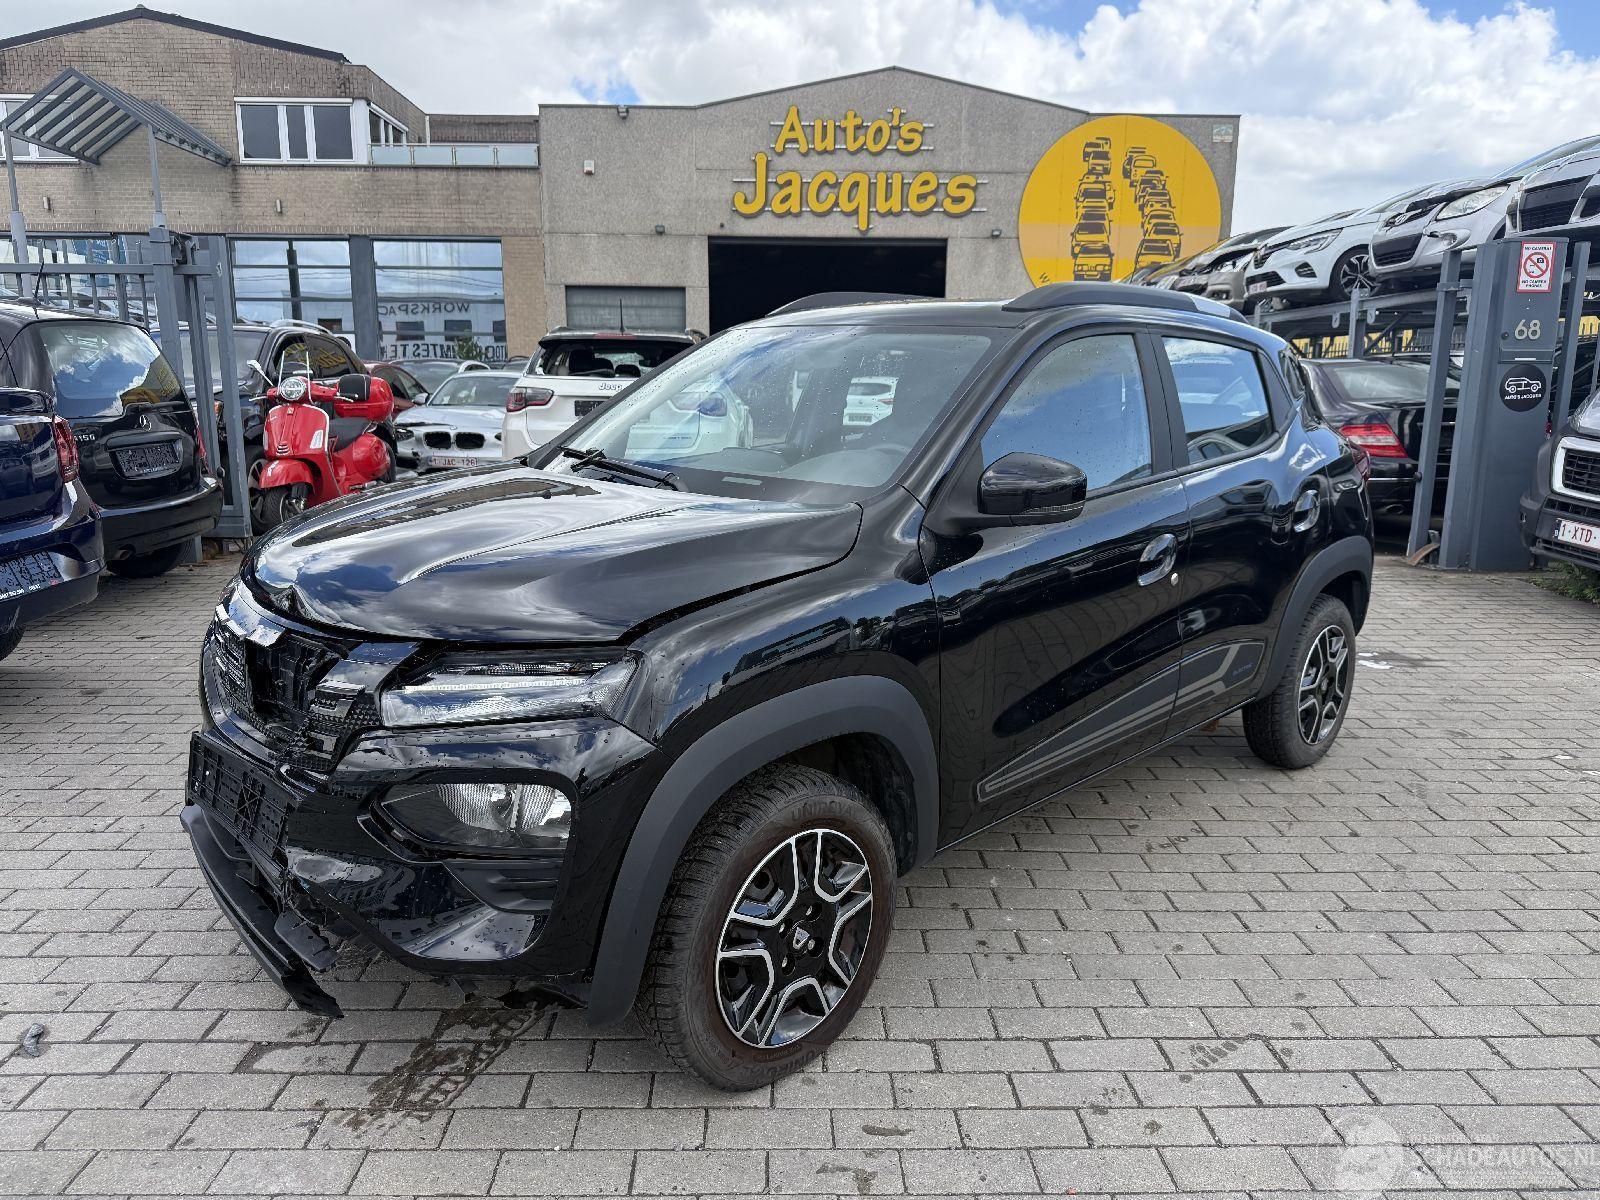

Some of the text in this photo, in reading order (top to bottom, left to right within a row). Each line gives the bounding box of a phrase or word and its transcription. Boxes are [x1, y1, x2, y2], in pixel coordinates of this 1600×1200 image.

[774, 105, 924, 154] Auto's
[733, 152, 977, 232] Jacques
[1514, 319, 1541, 340] 68
[599, 382, 622, 391] Jeep
